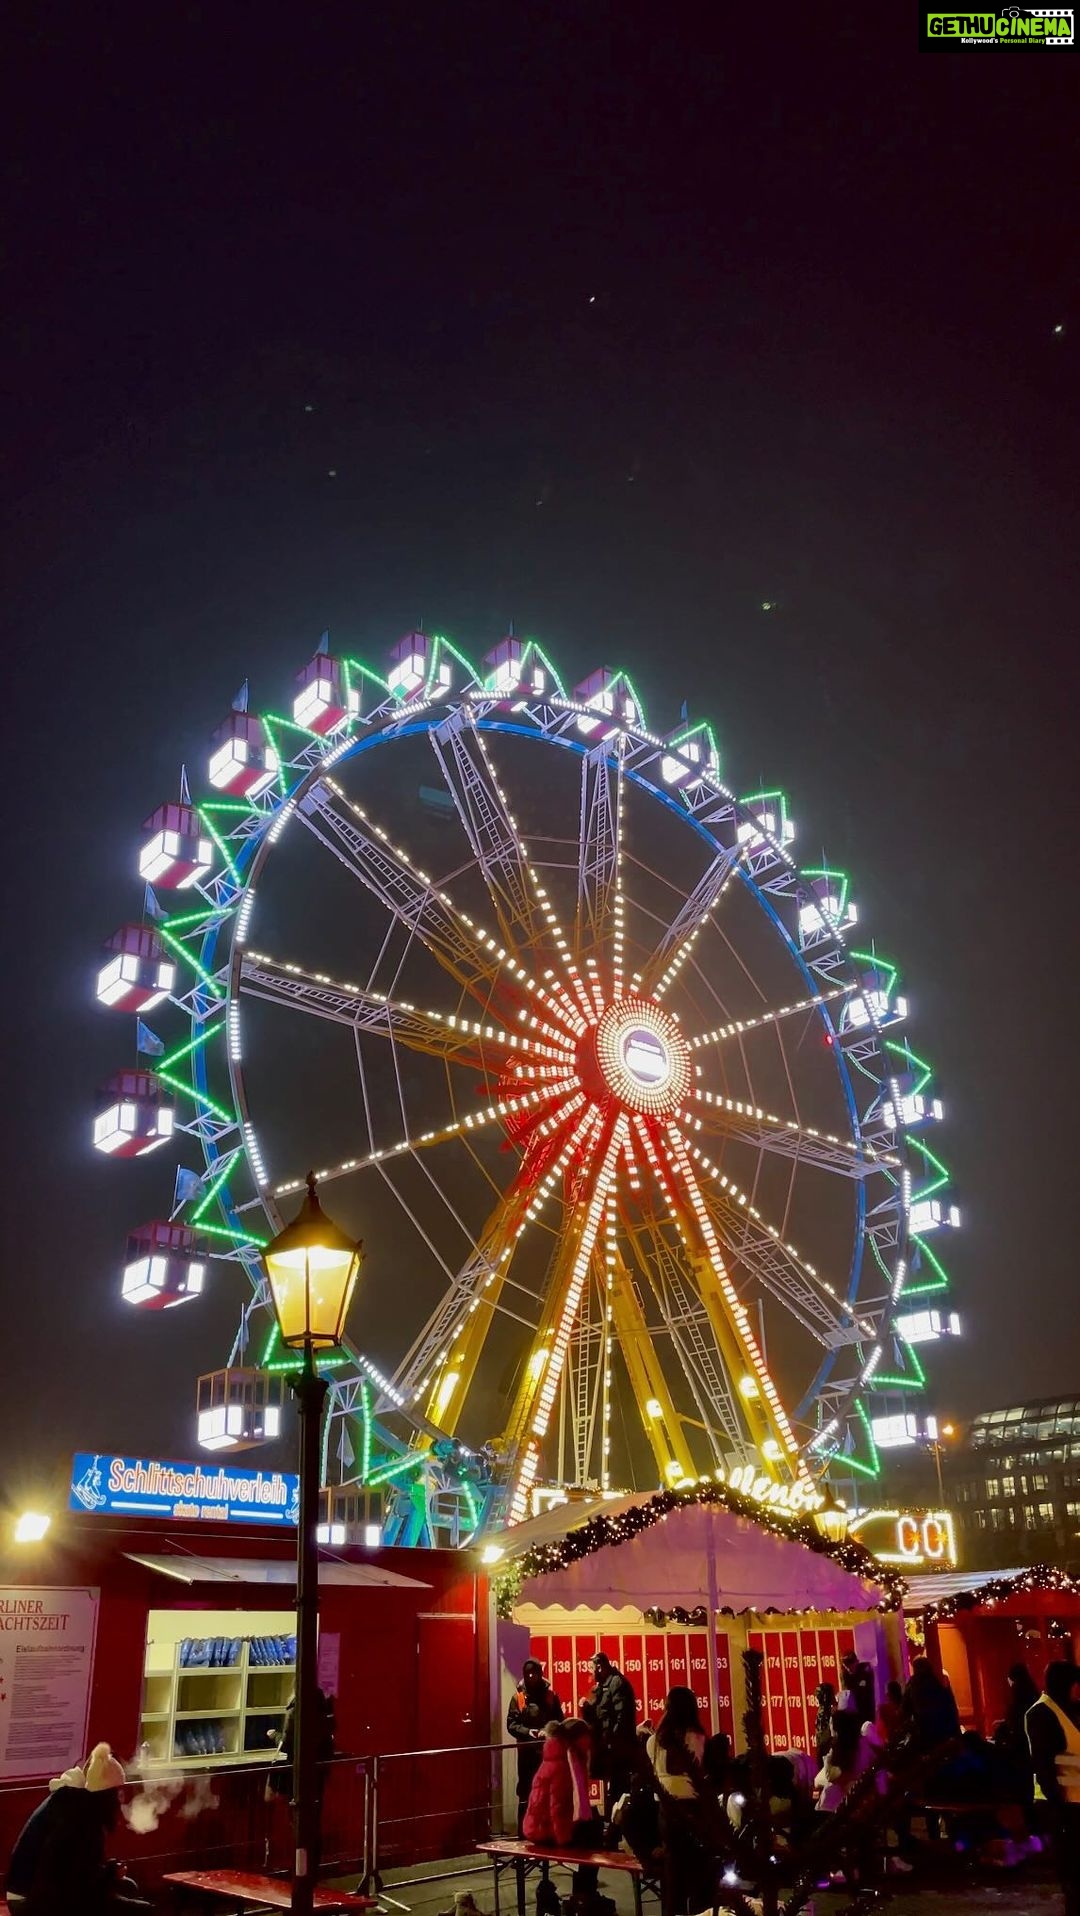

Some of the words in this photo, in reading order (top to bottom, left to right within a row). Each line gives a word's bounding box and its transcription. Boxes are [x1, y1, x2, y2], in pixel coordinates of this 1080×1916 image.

[108, 1458, 287, 1505] Schlittschuhverleih
[553, 1660, 571, 1674] 138
[625, 1659, 642, 1672] 150
[649, 1659, 664, 1672] 151
[670, 1658, 685, 1671] 161
[691, 1658, 707, 1671] 162
[716, 1657, 728, 1669] 63
[768, 1657, 780, 1669] 174
[785, 1657, 798, 1669] 175
[803, 1656, 817, 1667] 185
[822, 1655, 836, 1667] 186
[650, 1699, 665, 1711] 154
[697, 1697, 709, 1709] 65
[719, 1696, 730, 1708] 66
[771, 1696, 783, 1708] 177
[788, 1696, 802, 1708] 178
